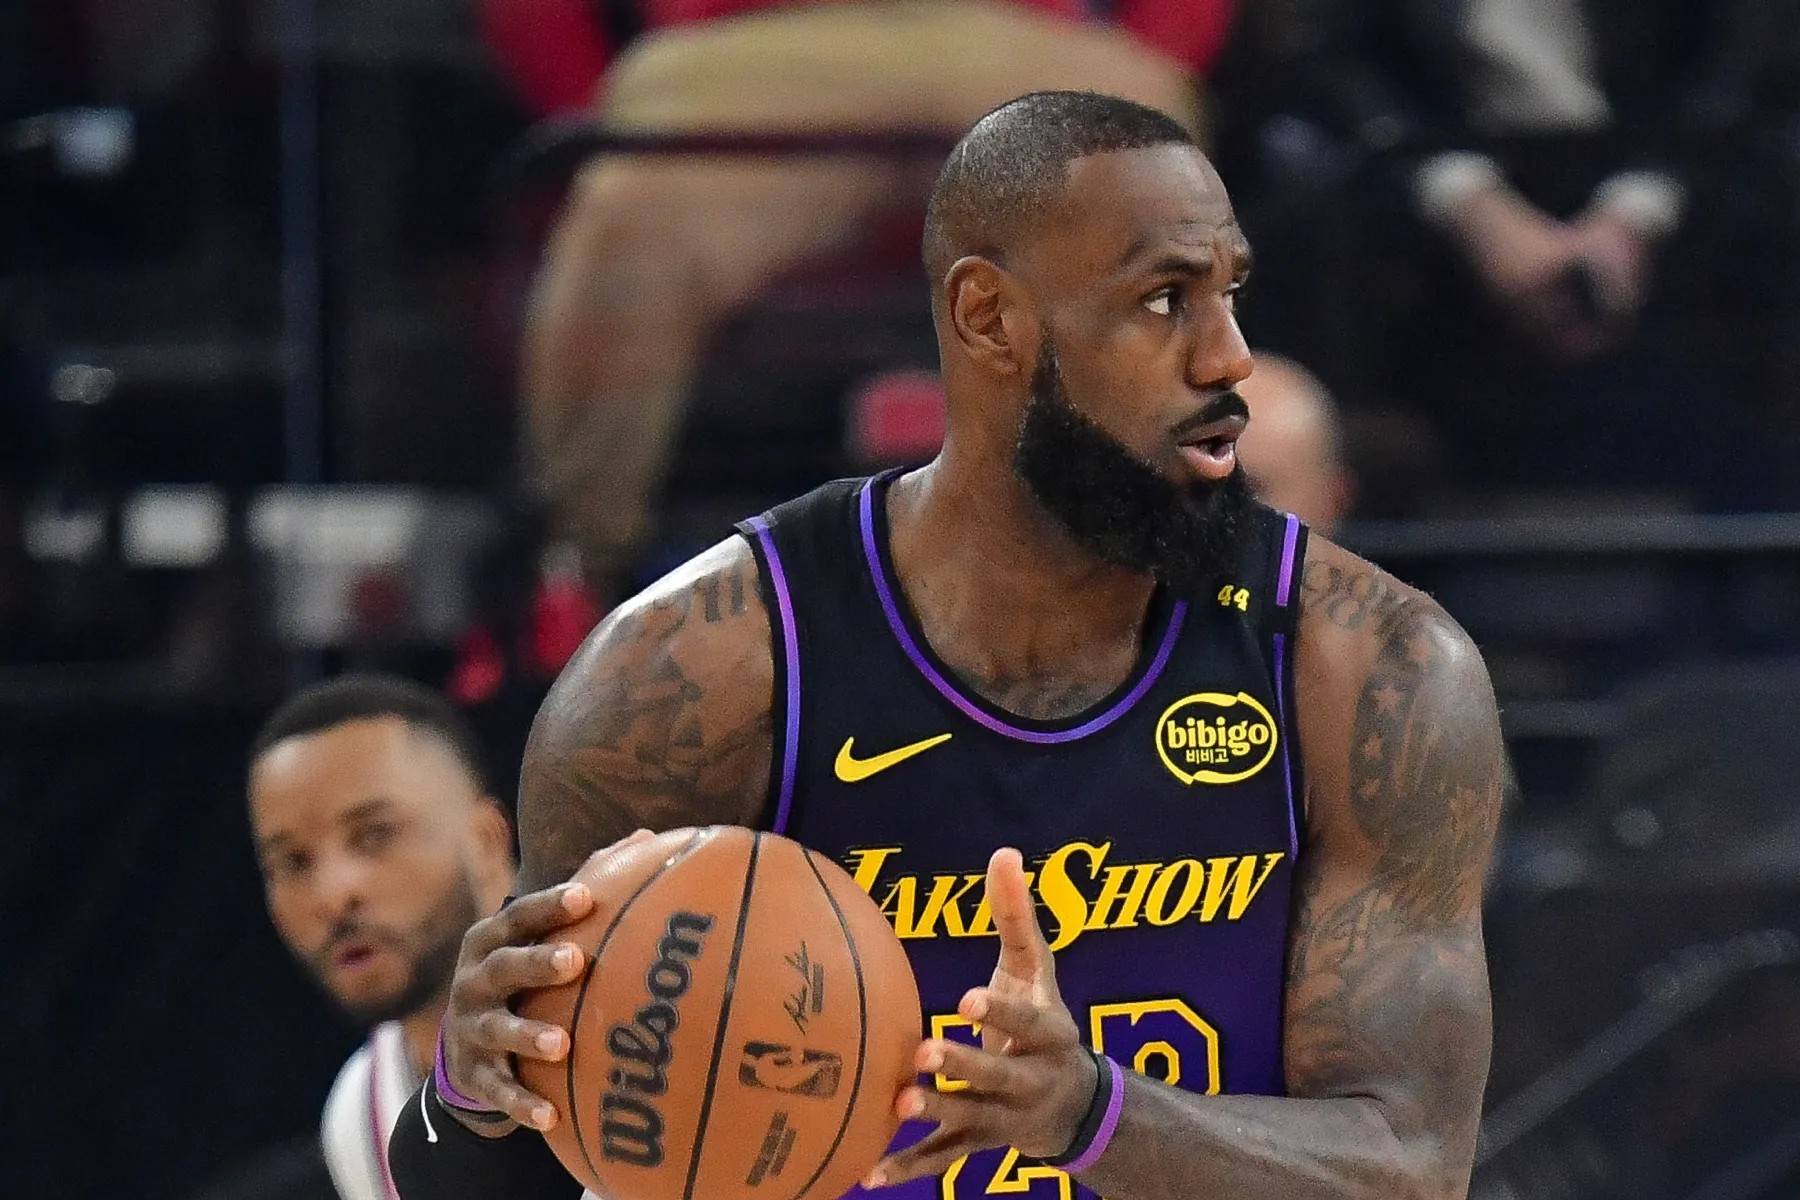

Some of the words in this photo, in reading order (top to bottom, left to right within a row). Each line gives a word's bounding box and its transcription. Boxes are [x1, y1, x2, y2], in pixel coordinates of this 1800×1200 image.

[1217, 584, 1250, 612] 44
[1167, 716, 1270, 756] bibigo
[1185, 748, 1230, 765] 비비고
[600, 910, 714, 1168] Wilson
